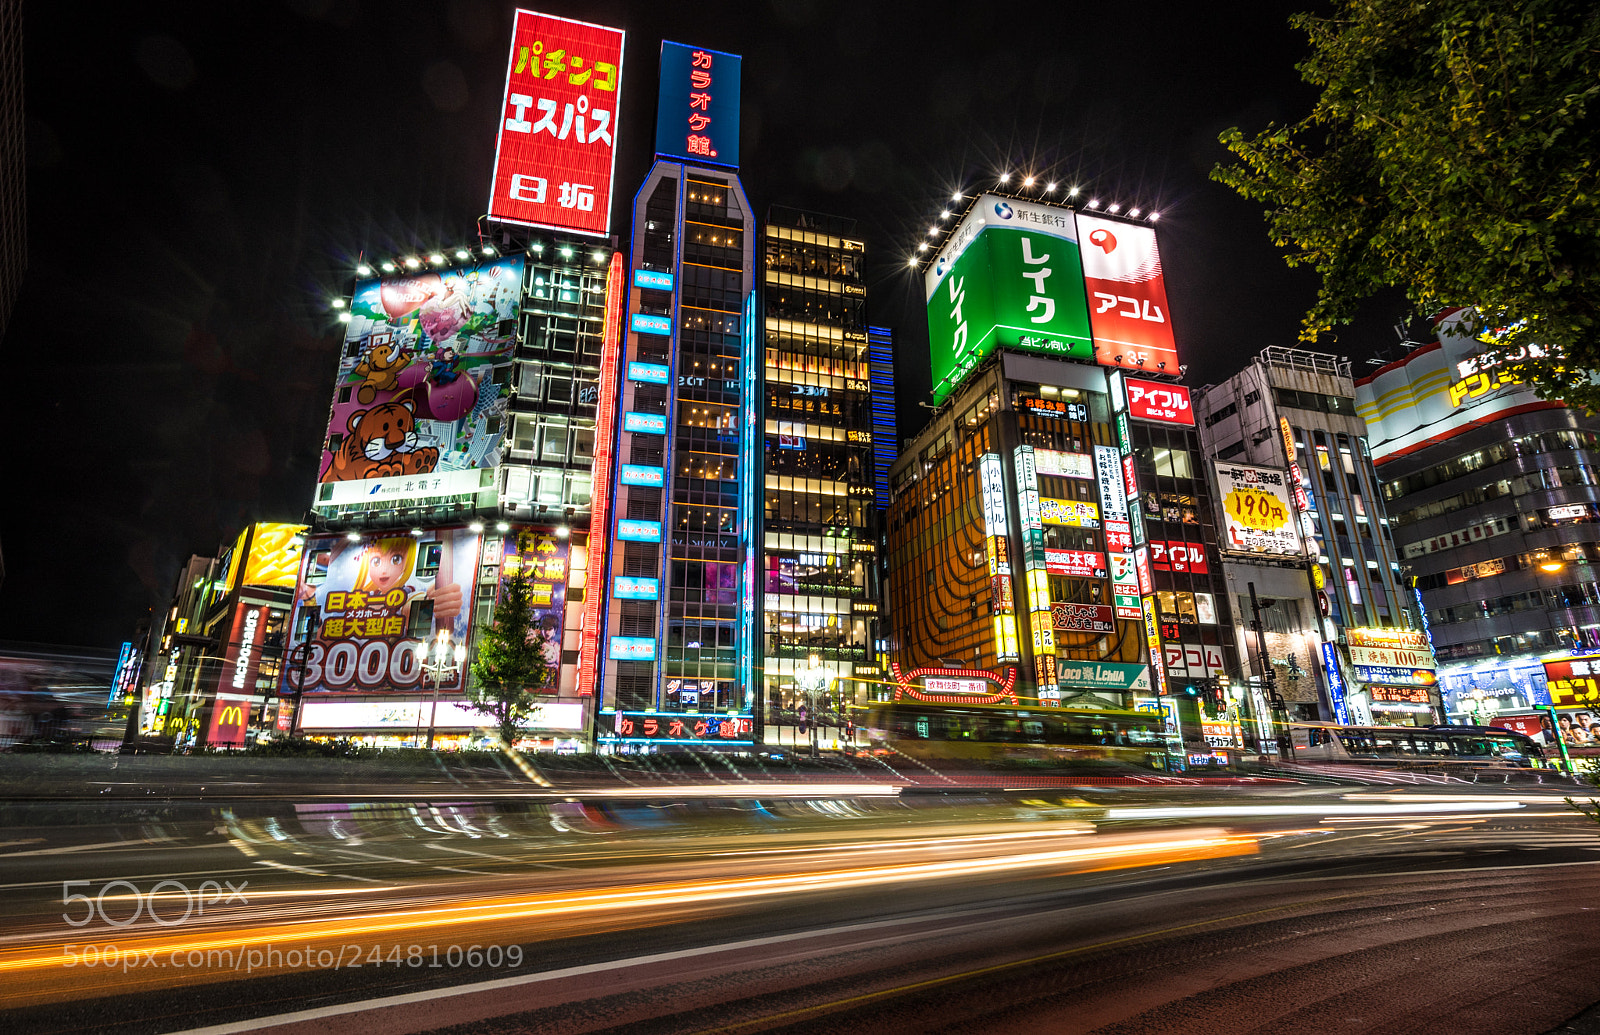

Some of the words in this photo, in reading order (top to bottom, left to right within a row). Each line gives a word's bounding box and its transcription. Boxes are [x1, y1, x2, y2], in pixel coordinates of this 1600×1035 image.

[514, 41, 616, 91] パチンコ
[687, 51, 712, 157] カラオケ館
[505, 93, 611, 147] エスパス
[510, 174, 594, 211] 日拓
[1017, 208, 1066, 228] 新生銀行
[1022, 237, 1056, 323] レイク
[949, 274, 968, 359] レイク
[1094, 291, 1165, 323] アコム
[1128, 386, 1189, 410] アイフル
[404, 478, 441, 491] 北電子
[990, 467, 1004, 524] 小松ビル
[1235, 493, 1284, 521] 190円
[1107, 533, 1131, 546] 本陣
[1070, 552, 1098, 568] 本陣
[1150, 544, 1204, 566] アイフル
[503, 555, 565, 581] 最大級
[1095, 569, 1105, 577] 4F
[327, 588, 404, 611] 日本一の
[1115, 585, 1138, 595] たばこ
[347, 609, 389, 618] メガホール
[324, 616, 403, 638] 超大型店
[232, 609, 260, 689] McDonald's
[1165, 649, 1223, 668] アコム
[1368, 650, 1389, 664] 焼鳥
[667, 680, 713, 695] ダーツ
[1137, 678, 1148, 688] 3F
[621, 719, 738, 738] カラオケ館
